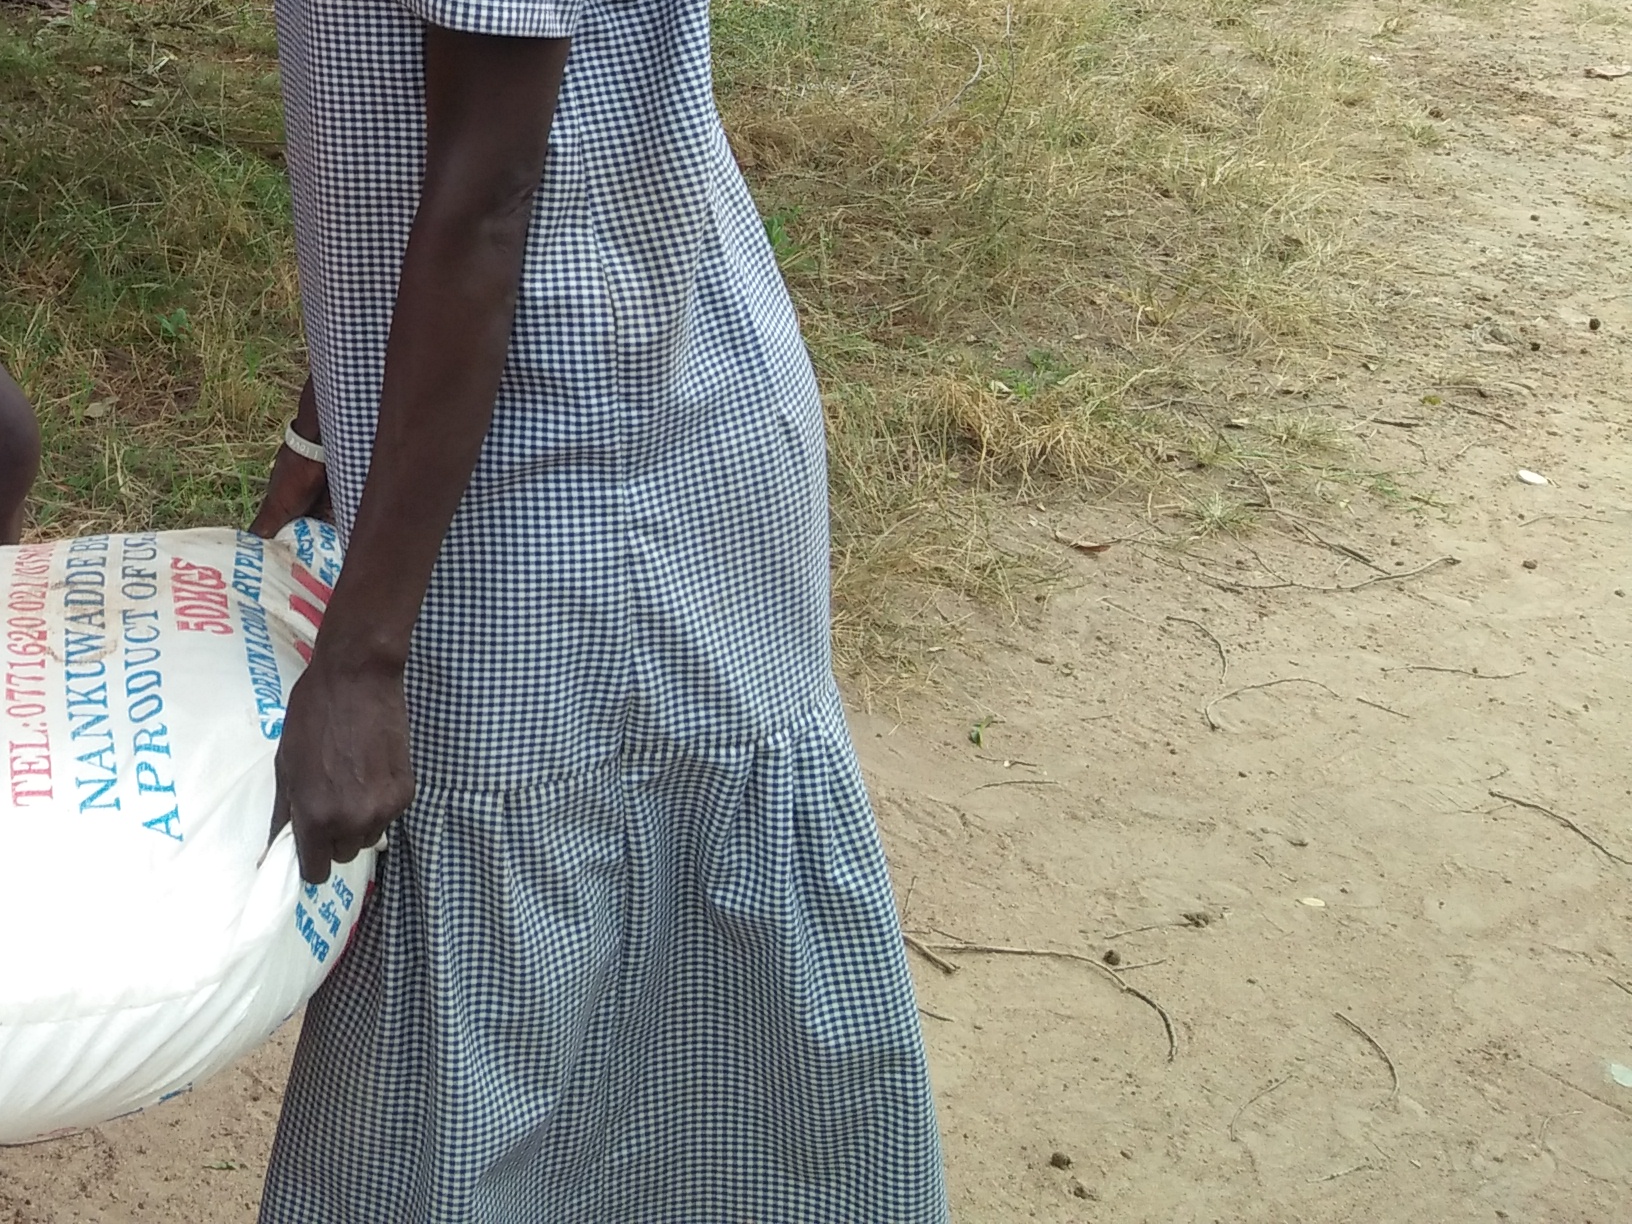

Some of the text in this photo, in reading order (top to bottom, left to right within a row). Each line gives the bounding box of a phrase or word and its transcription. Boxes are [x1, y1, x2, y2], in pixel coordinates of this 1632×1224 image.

[64, 556, 121, 814] NANKUWADDE
[121, 607, 178, 797] PRODUCT
[142, 804, 184, 842] A
